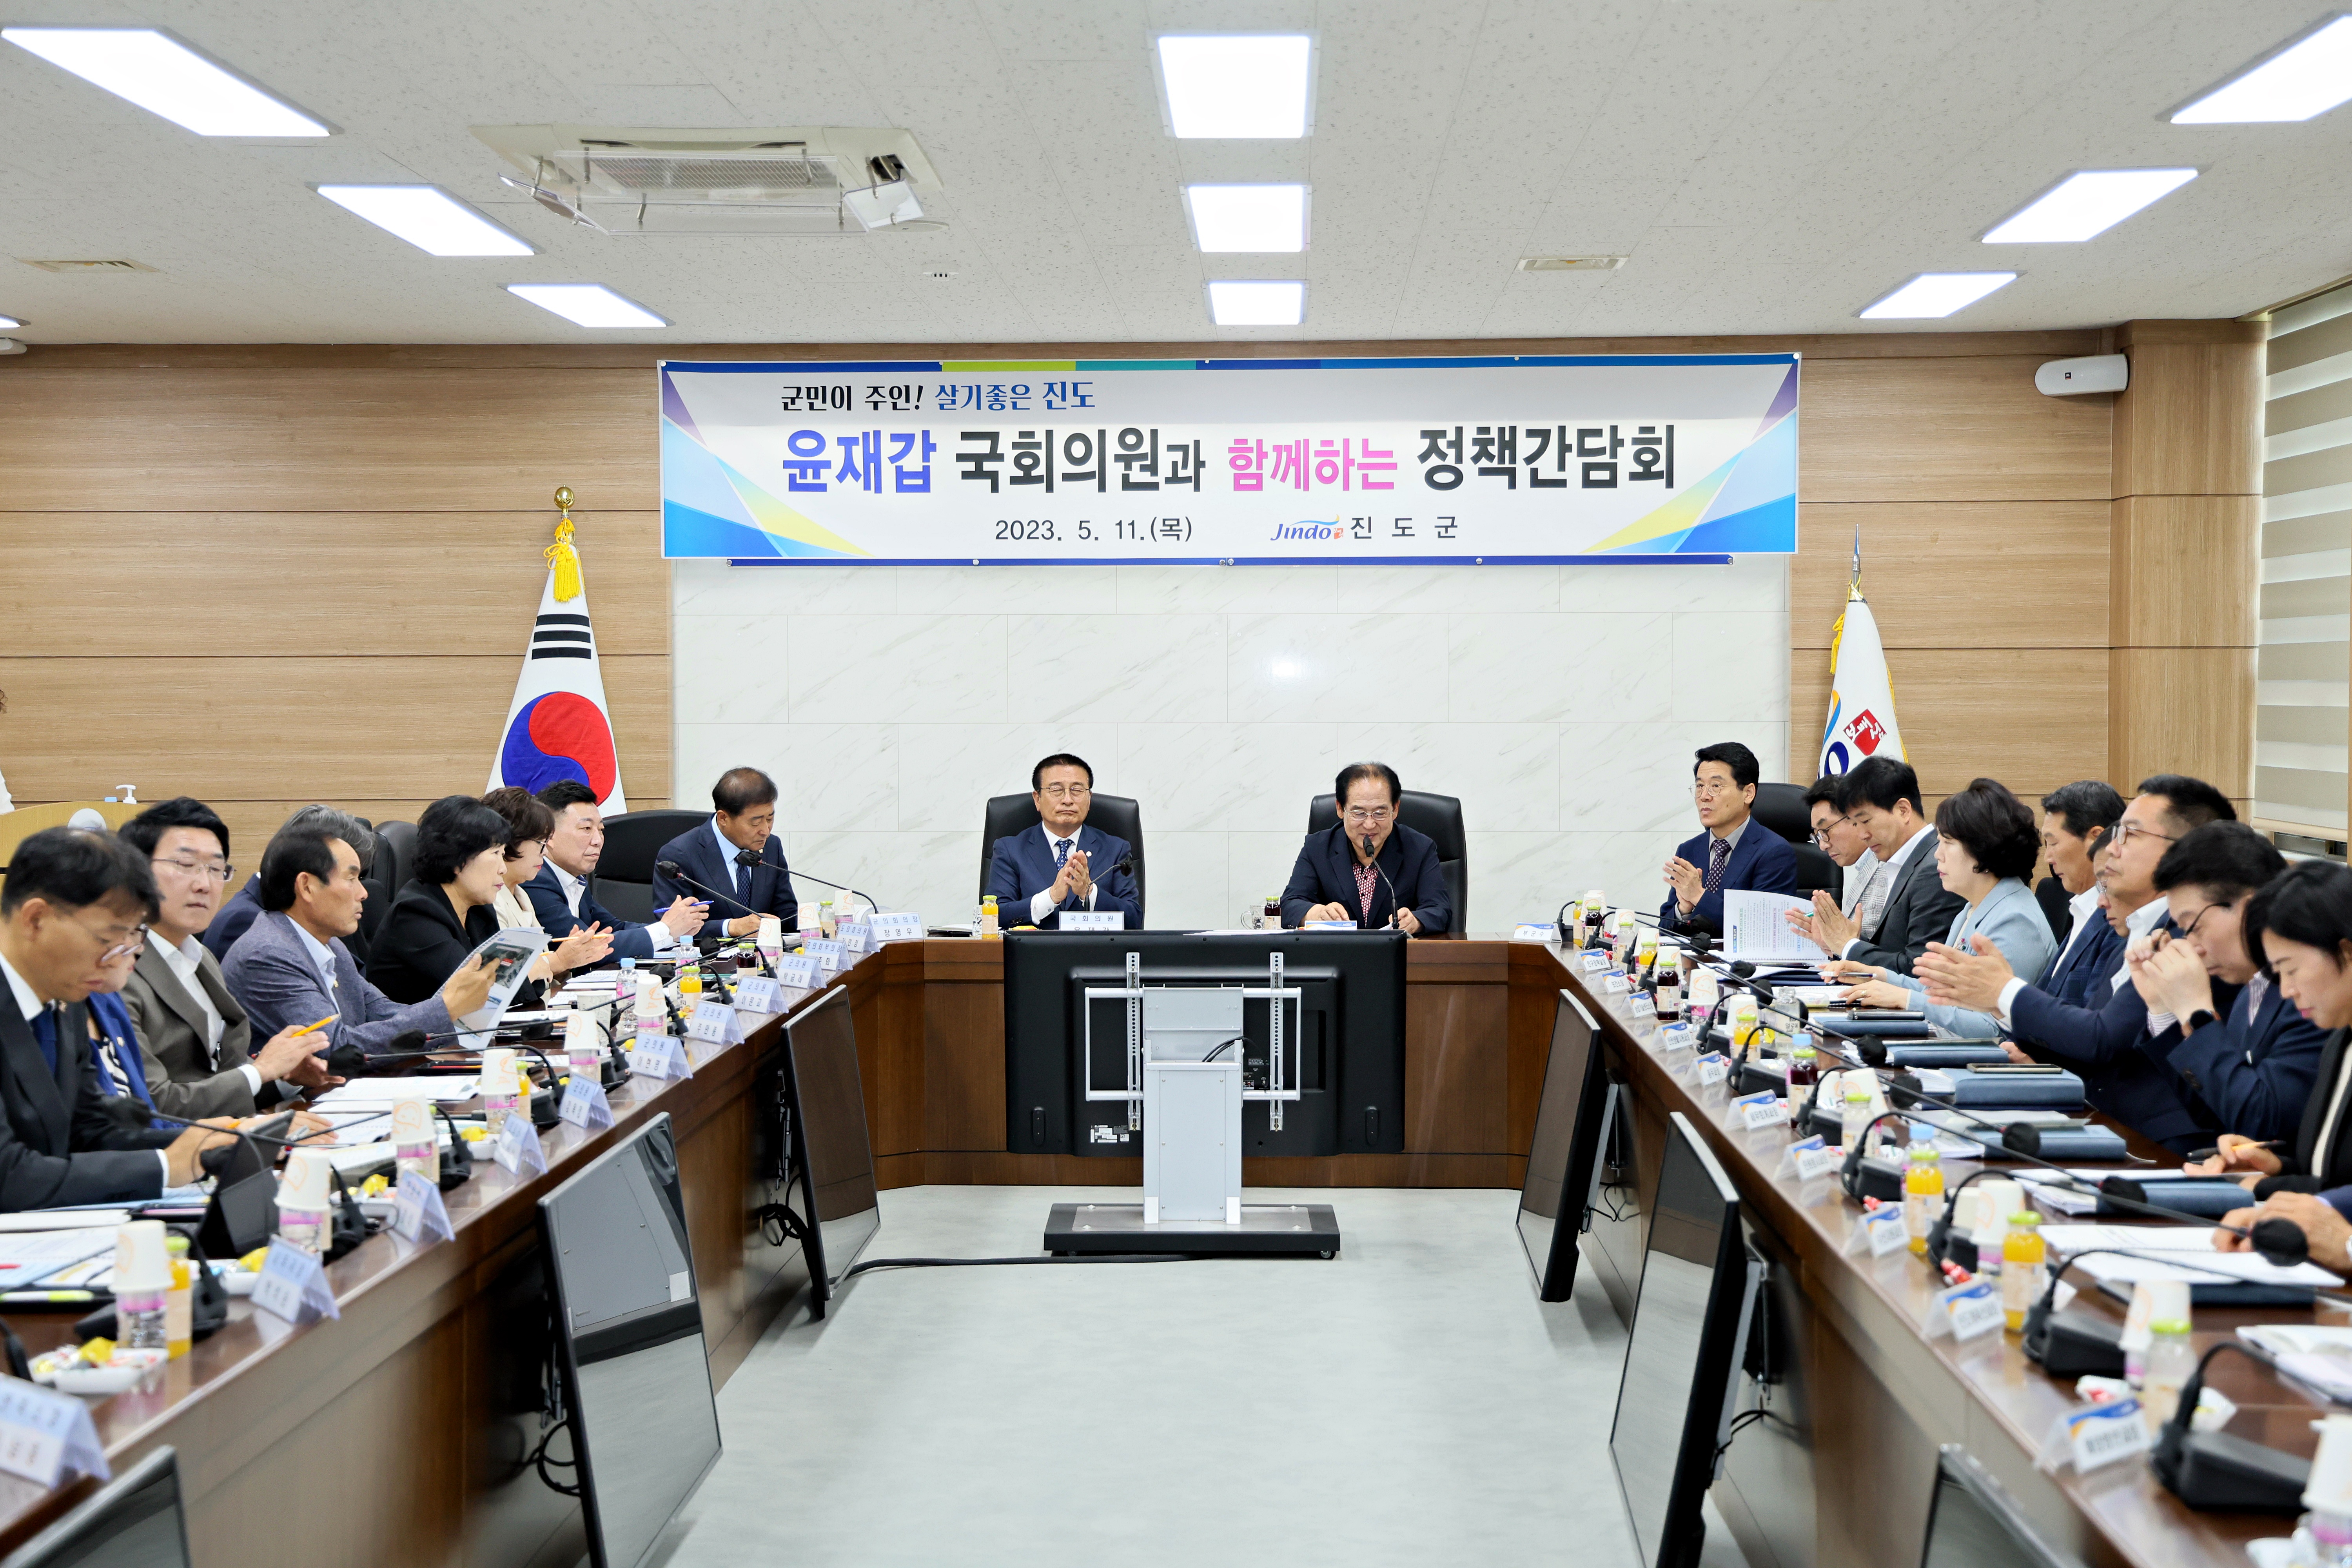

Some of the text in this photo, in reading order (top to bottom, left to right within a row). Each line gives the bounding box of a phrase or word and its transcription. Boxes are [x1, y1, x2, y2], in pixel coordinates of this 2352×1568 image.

[782, 381, 1095, 411] 군민이 주인! 살기좋은 진도
[783, 425, 1674, 494] 윤재갑 국회의원과 함께하는 정책간담회
[996, 517, 1192, 542] 2023. 5. 11.(목)
[1270, 523, 1331, 541] Jindo
